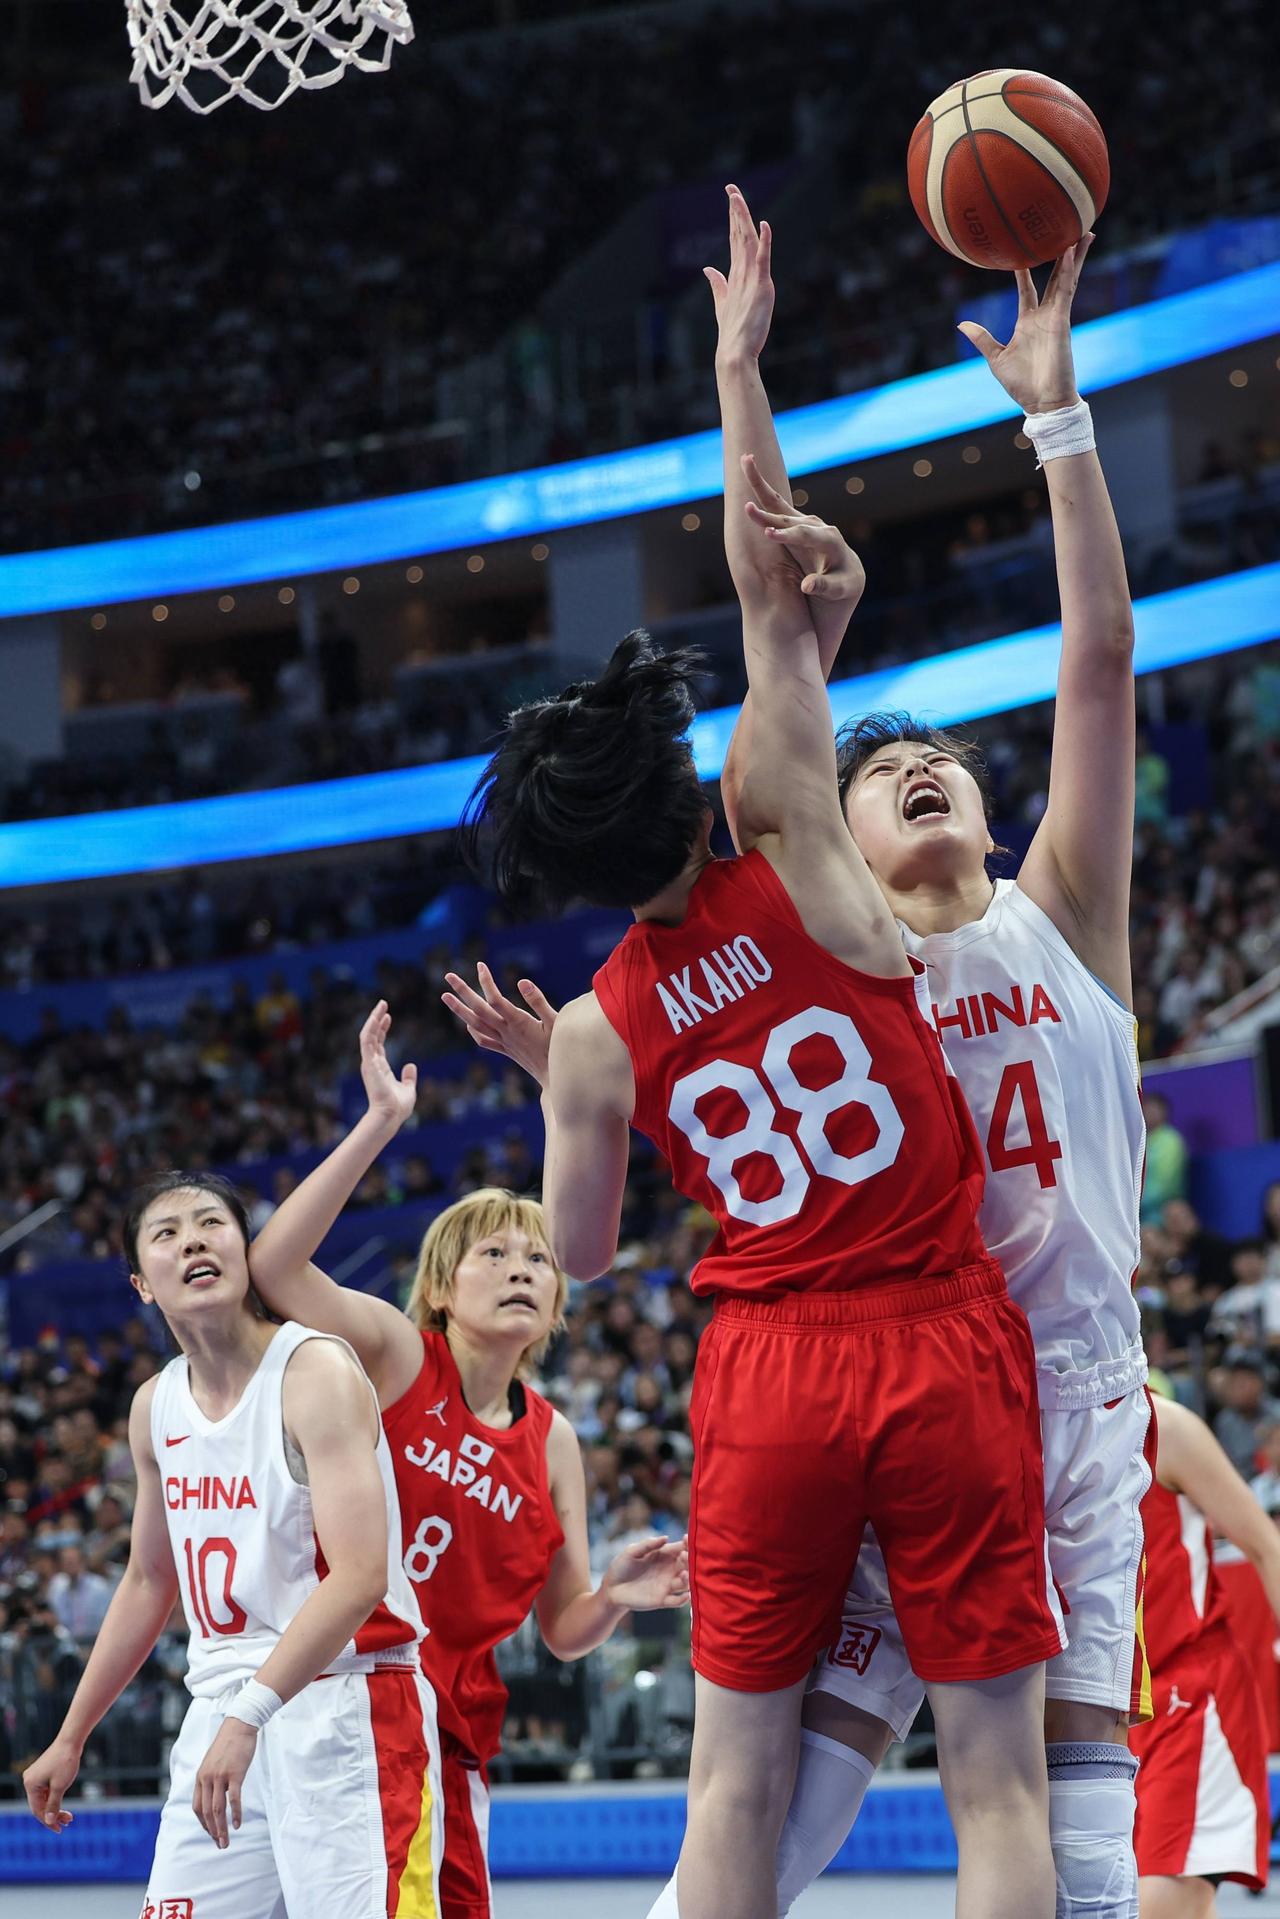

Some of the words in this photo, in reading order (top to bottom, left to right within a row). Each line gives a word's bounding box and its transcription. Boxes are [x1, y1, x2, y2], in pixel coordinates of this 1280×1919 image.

[656, 934, 772, 1035] AKAHO
[931, 983, 1061, 1043] HINA
[668, 1005, 905, 1227] 88
[166, 1476, 257, 1510] CHINA
[404, 1437, 523, 1523] JAPAN
[184, 1537, 247, 1638] 10
[403, 1515, 453, 1583] 8
